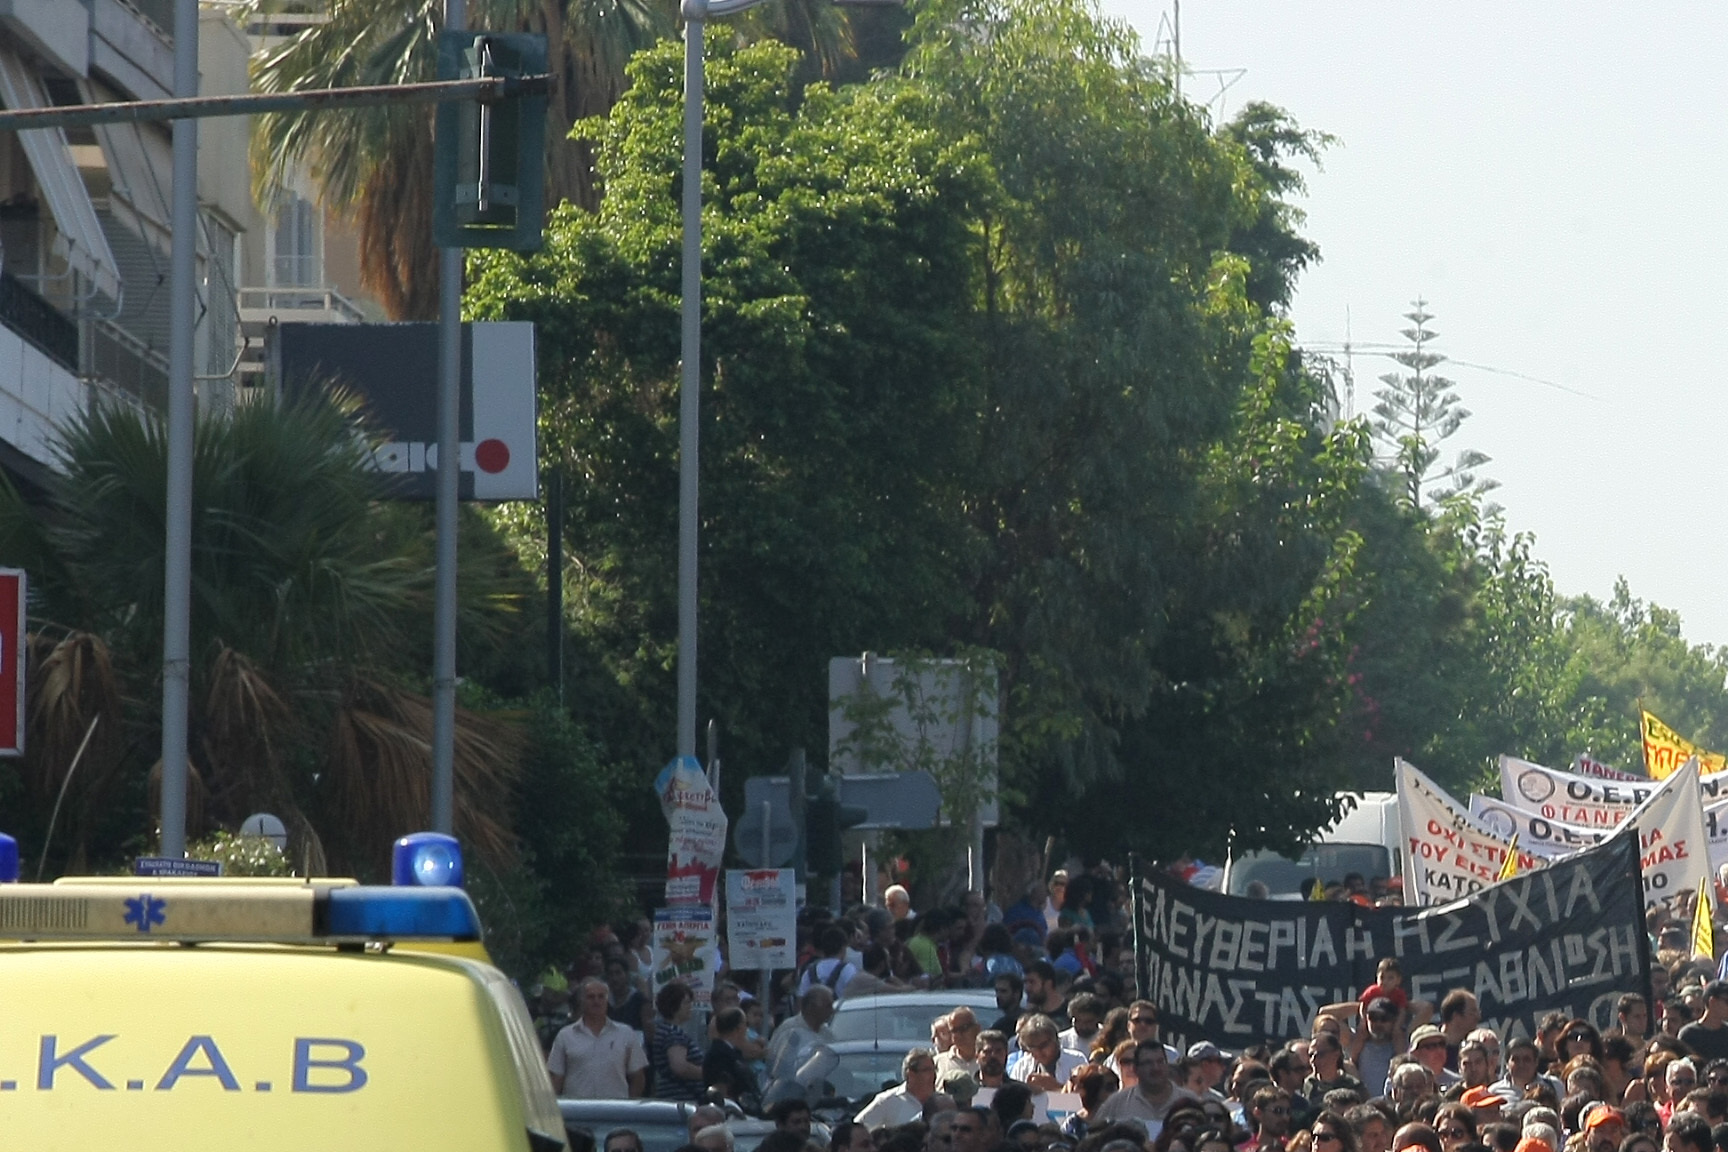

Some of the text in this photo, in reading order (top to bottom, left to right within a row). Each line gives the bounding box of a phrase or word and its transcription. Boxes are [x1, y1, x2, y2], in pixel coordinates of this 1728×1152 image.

[1408, 837, 1449, 862] ΤΟΥ
[1427, 819, 1466, 850] ΟΧΙ
[1142, 877, 1338, 973] ΕΛΕΥΘΕΡΙΑ
[1393, 863, 1601, 958] ΗΣΥΧΙΑ
